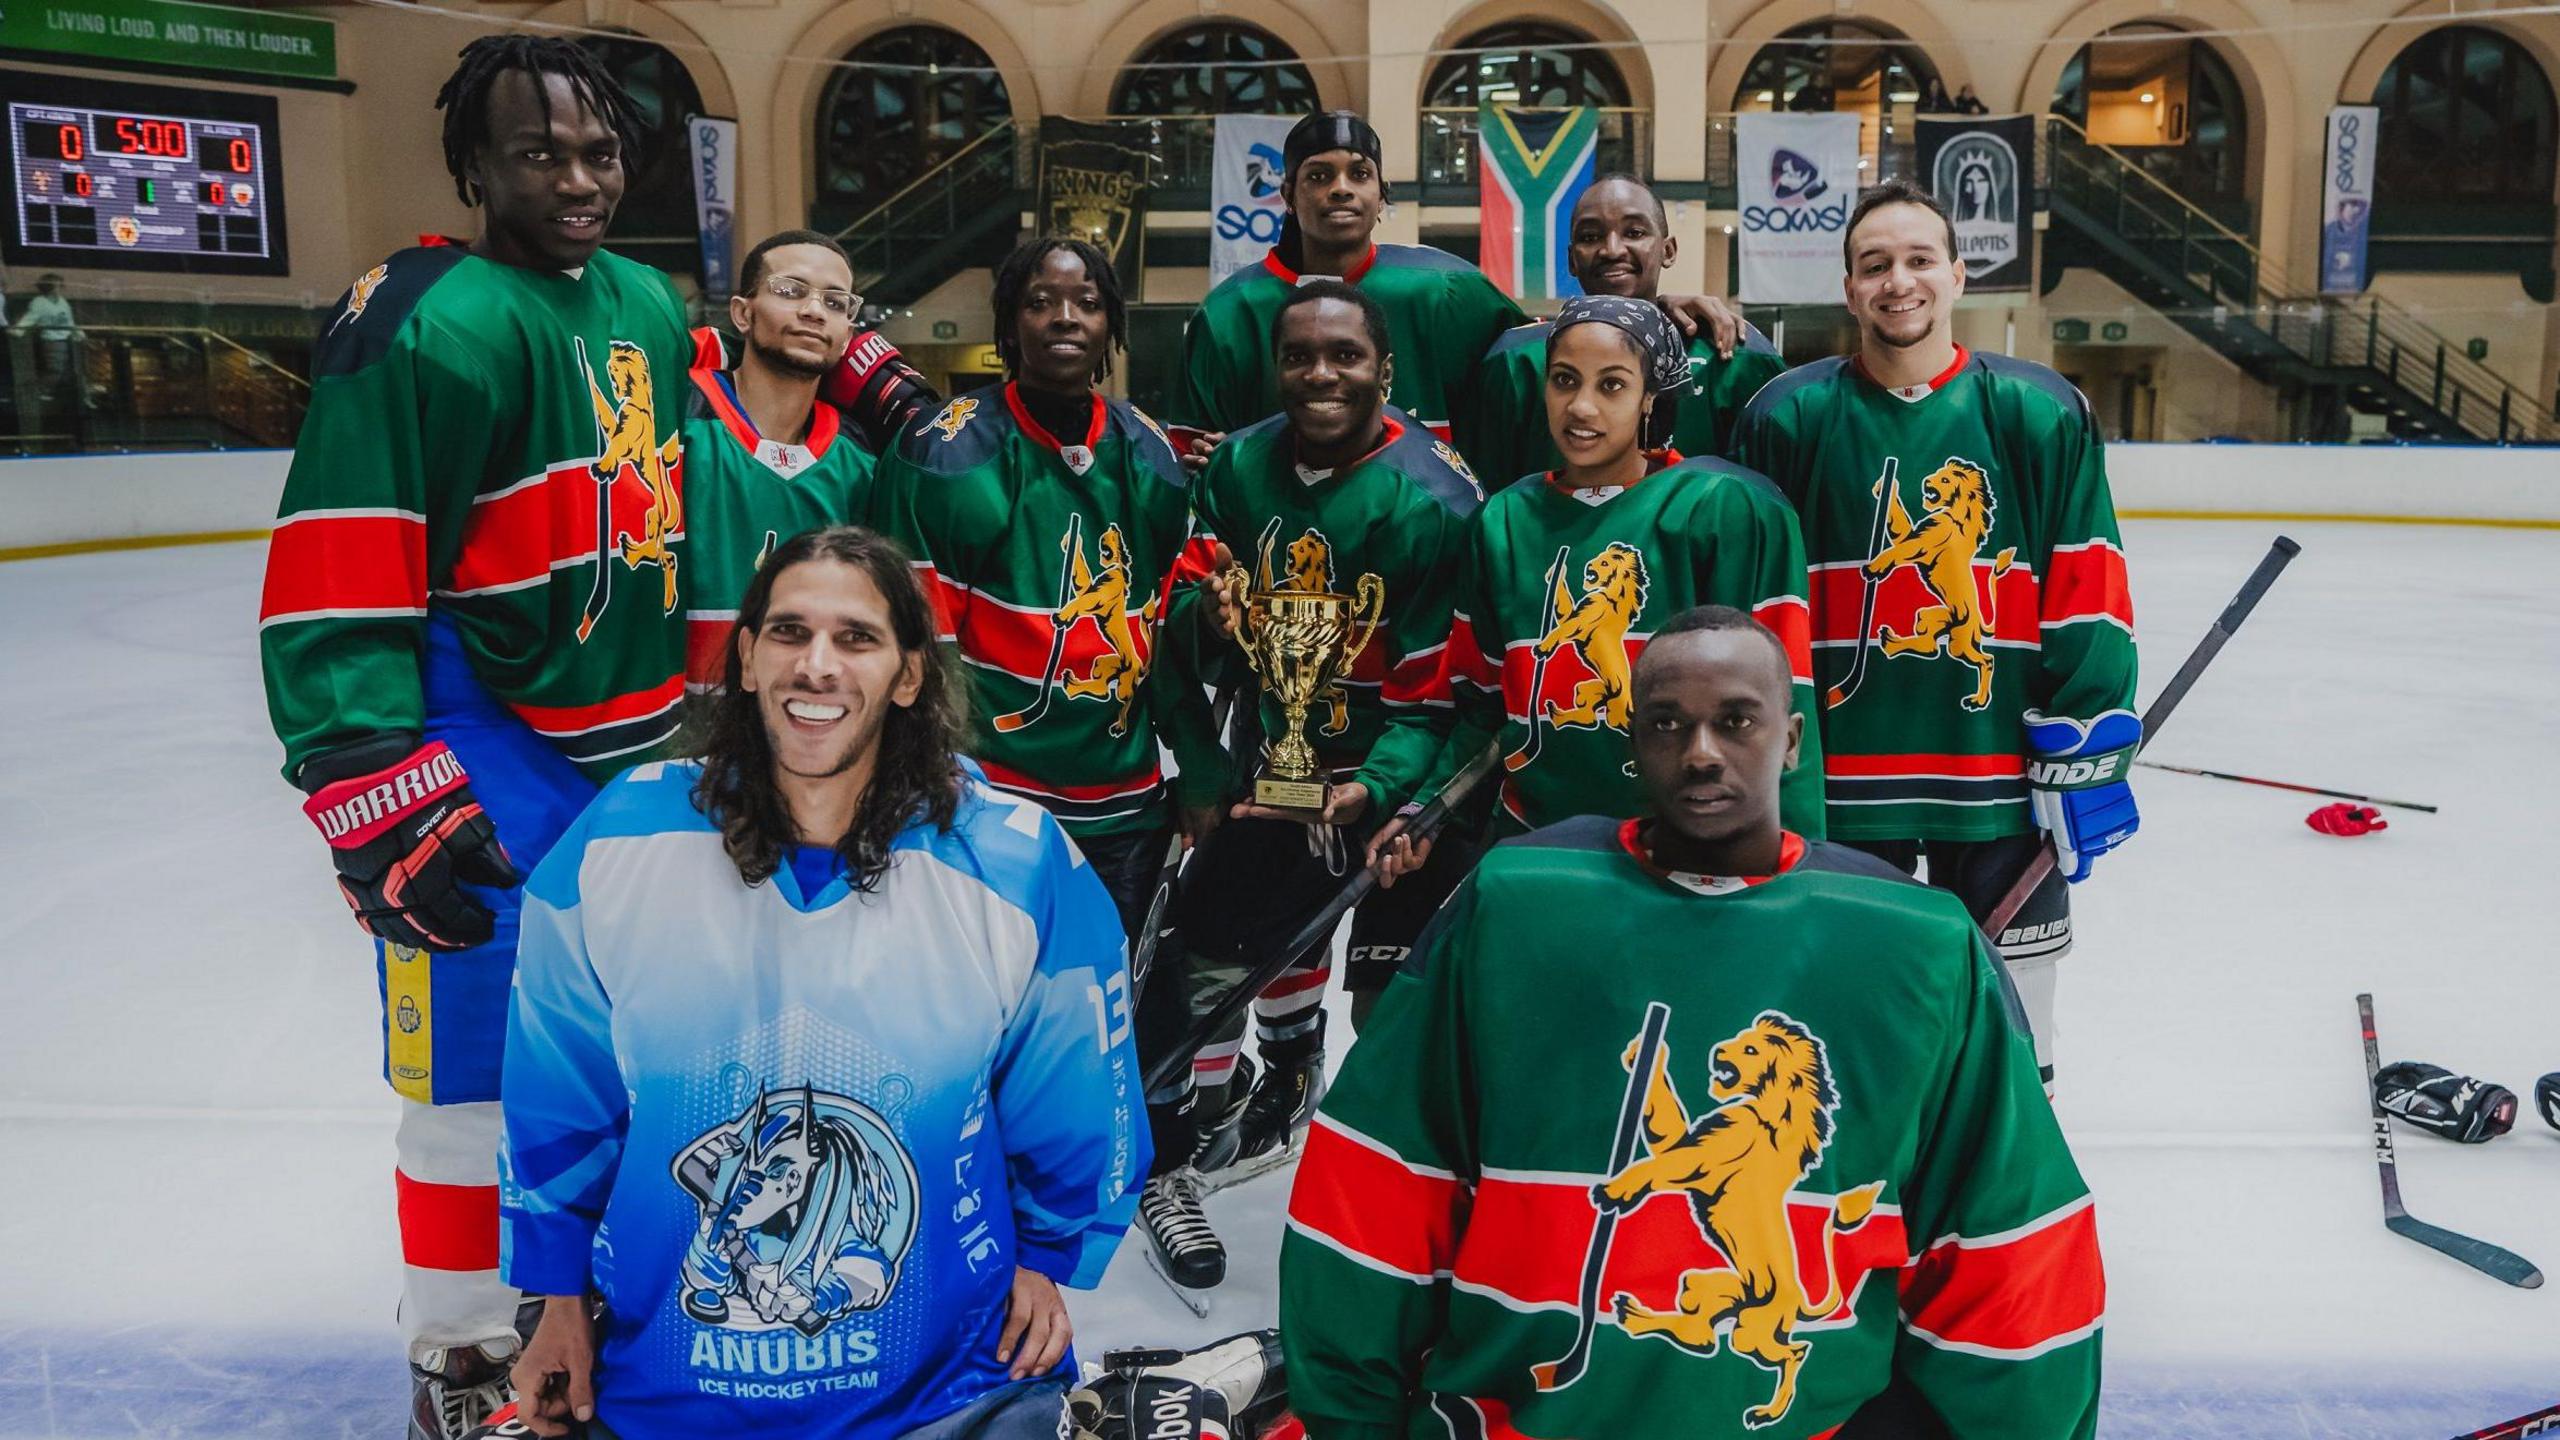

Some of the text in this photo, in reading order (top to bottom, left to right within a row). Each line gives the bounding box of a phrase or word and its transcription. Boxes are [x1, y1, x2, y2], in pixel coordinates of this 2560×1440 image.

[46, 9, 106, 35] LIVING
[165, 22, 199, 44] AND
[202, 26, 247, 49] THEN
[60, 124, 84, 160] 0
[115, 118, 186, 158] 5:00
[229, 138, 252, 173] 0
[75, 173, 92, 198] 0
[209, 182, 225, 206] 0
[1051, 165, 1136, 204] KINGS
[1956, 234, 2010, 252] ueens
[316, 750, 467, 840] WARRIOR
[1087, 970, 1132, 1056] 13
[689, 1330, 879, 1376] ANUBIS
[698, 1371, 879, 1400] ICE HOCKEY TEAM
